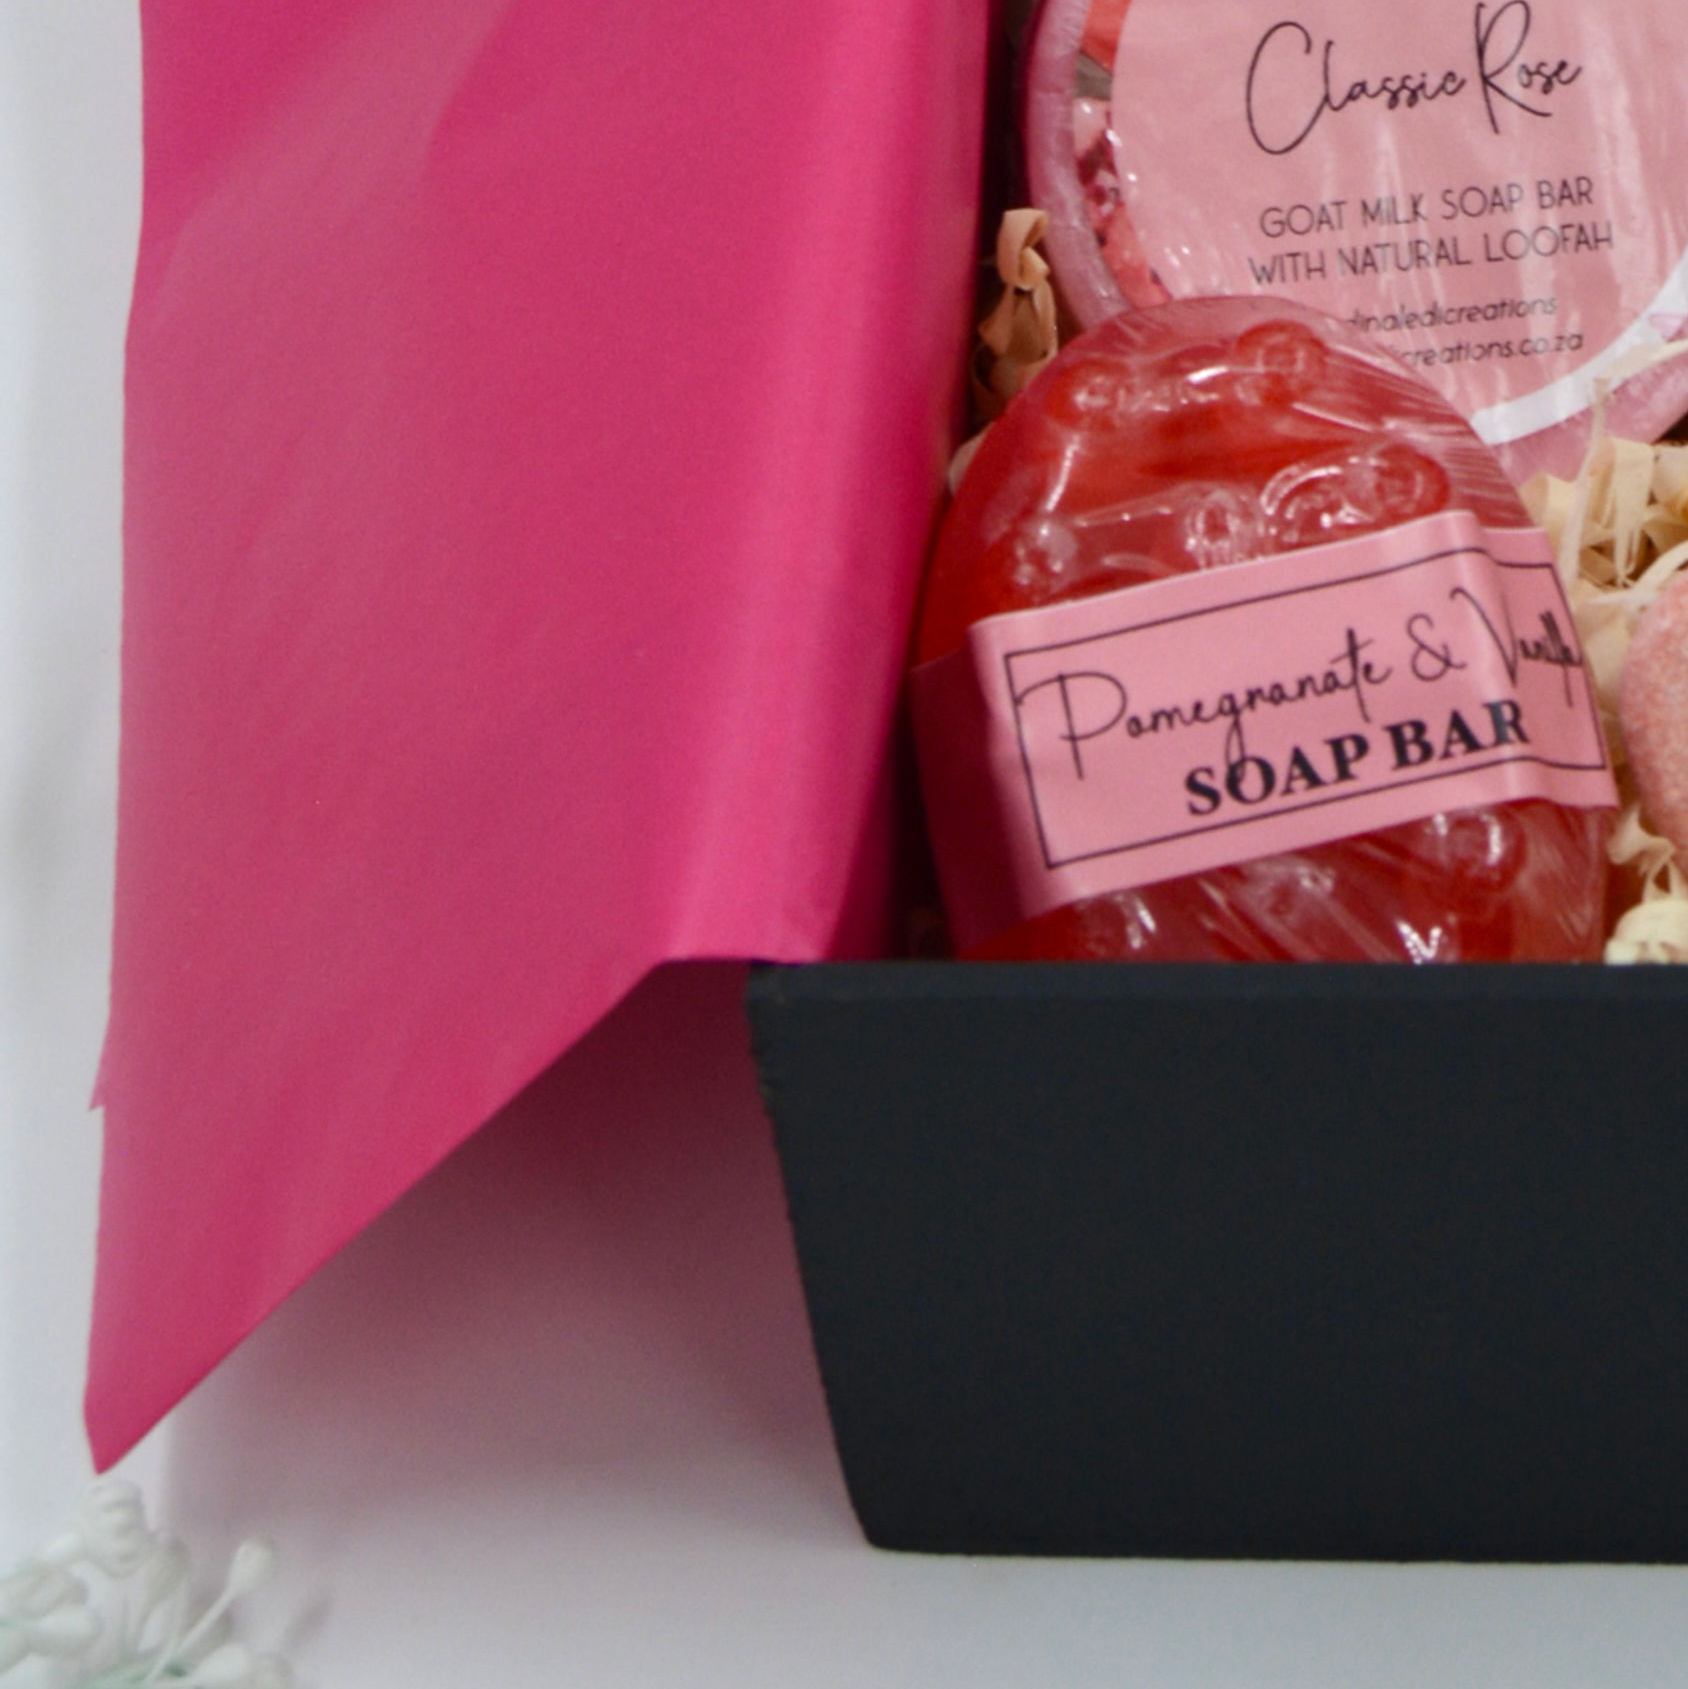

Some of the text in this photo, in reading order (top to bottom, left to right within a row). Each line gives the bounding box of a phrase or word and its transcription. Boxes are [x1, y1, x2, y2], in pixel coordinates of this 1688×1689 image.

[1246, 0, 1584, 156] Classic Rose
[1248, 220, 1614, 285] WITH NATURAL LOOFAH
[1259, 175, 1594, 238] GOAT MILK SOAP BAR
[1016, 626, 1392, 783] Pomegranate
[1405, 612, 1468, 682] &
[1184, 698, 1531, 817] SOAP BAR
